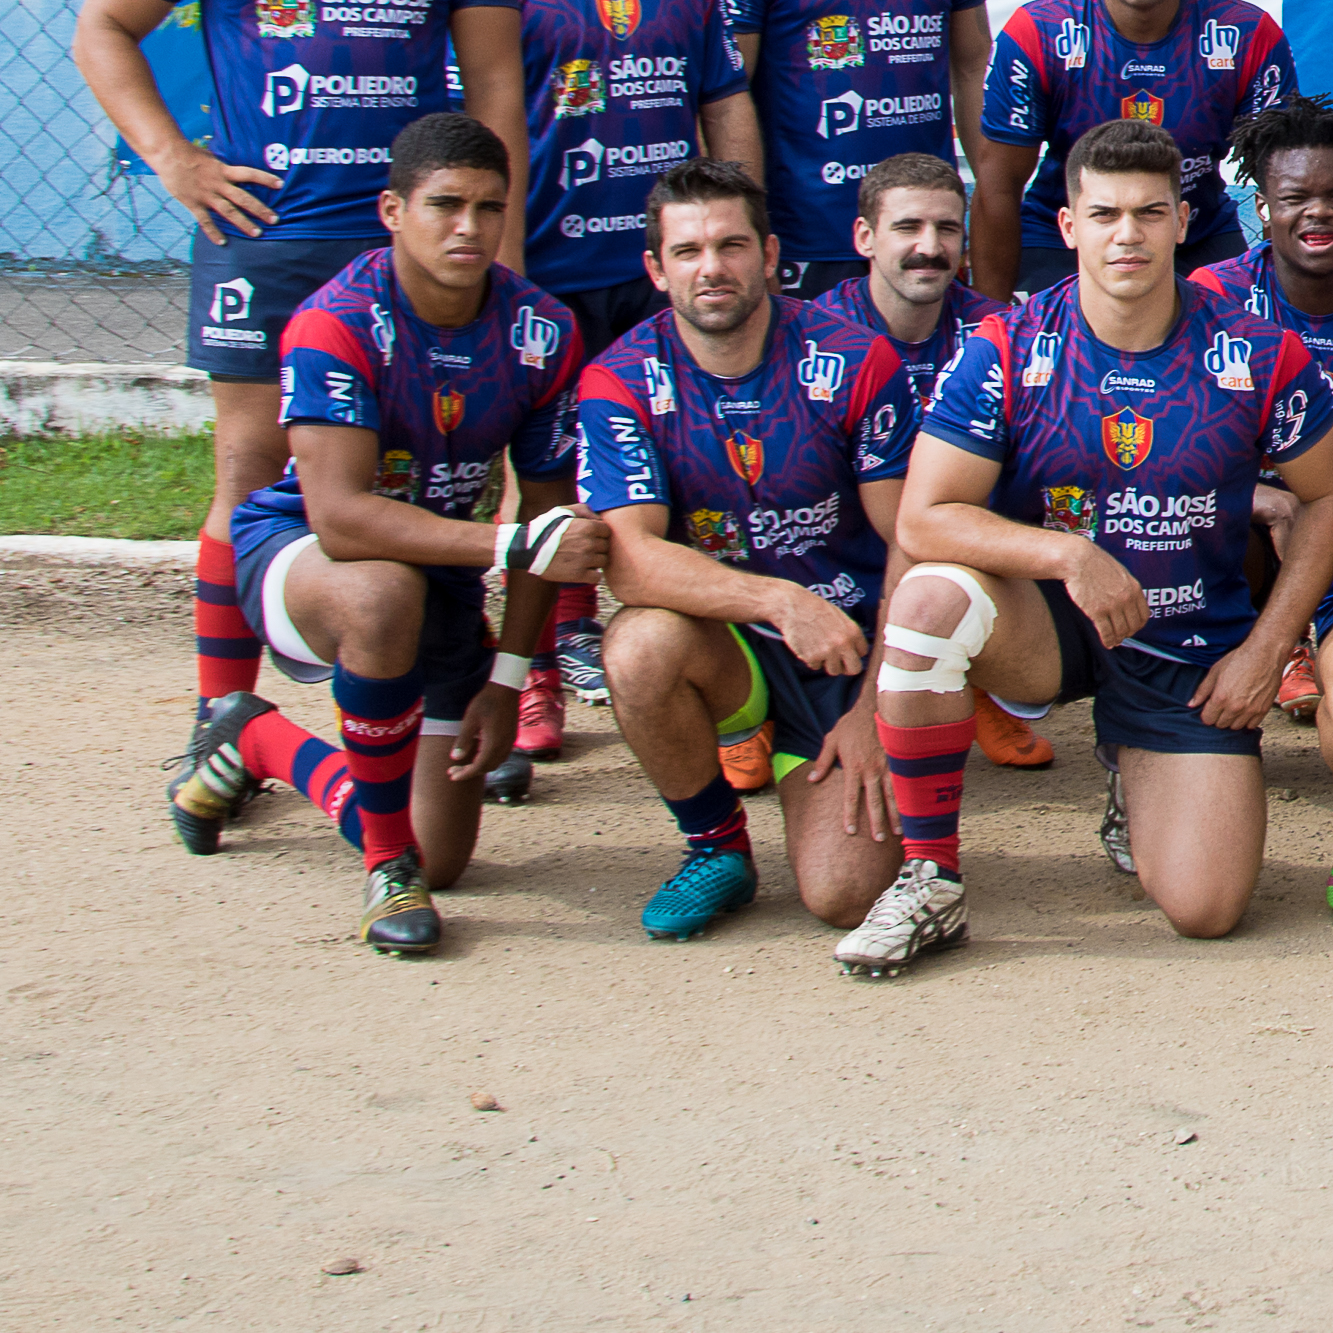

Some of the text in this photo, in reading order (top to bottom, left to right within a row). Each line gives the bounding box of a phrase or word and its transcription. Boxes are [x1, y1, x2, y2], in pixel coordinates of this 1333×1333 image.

[322, 7, 361, 21] DOS
[868, 11, 944, 36] SÃO JOSÉ
[870, 36, 942, 52] DOS CAMPOS
[609, 54, 654, 79] SÃO
[1127, 64, 1166, 73] SANRAD
[310, 76, 418, 96] POLIEDRO
[610, 82, 645, 97] DOS
[866, 94, 941, 116] POLIEDRO
[867, 115, 906, 129] SISTEMA
[908, 114, 917, 125] DE
[290, 148, 354, 164] QUERO
[606, 140, 690, 166] POLIEDRO
[1108, 375, 1156, 389] SANRAD
[608, 416, 657, 501] PLANI
[1105, 487, 1217, 519] SÃO JOSÉ
[1104, 514, 1216, 536] DOS CAMPOS
[1164, 597, 1207, 618] ENSINO
